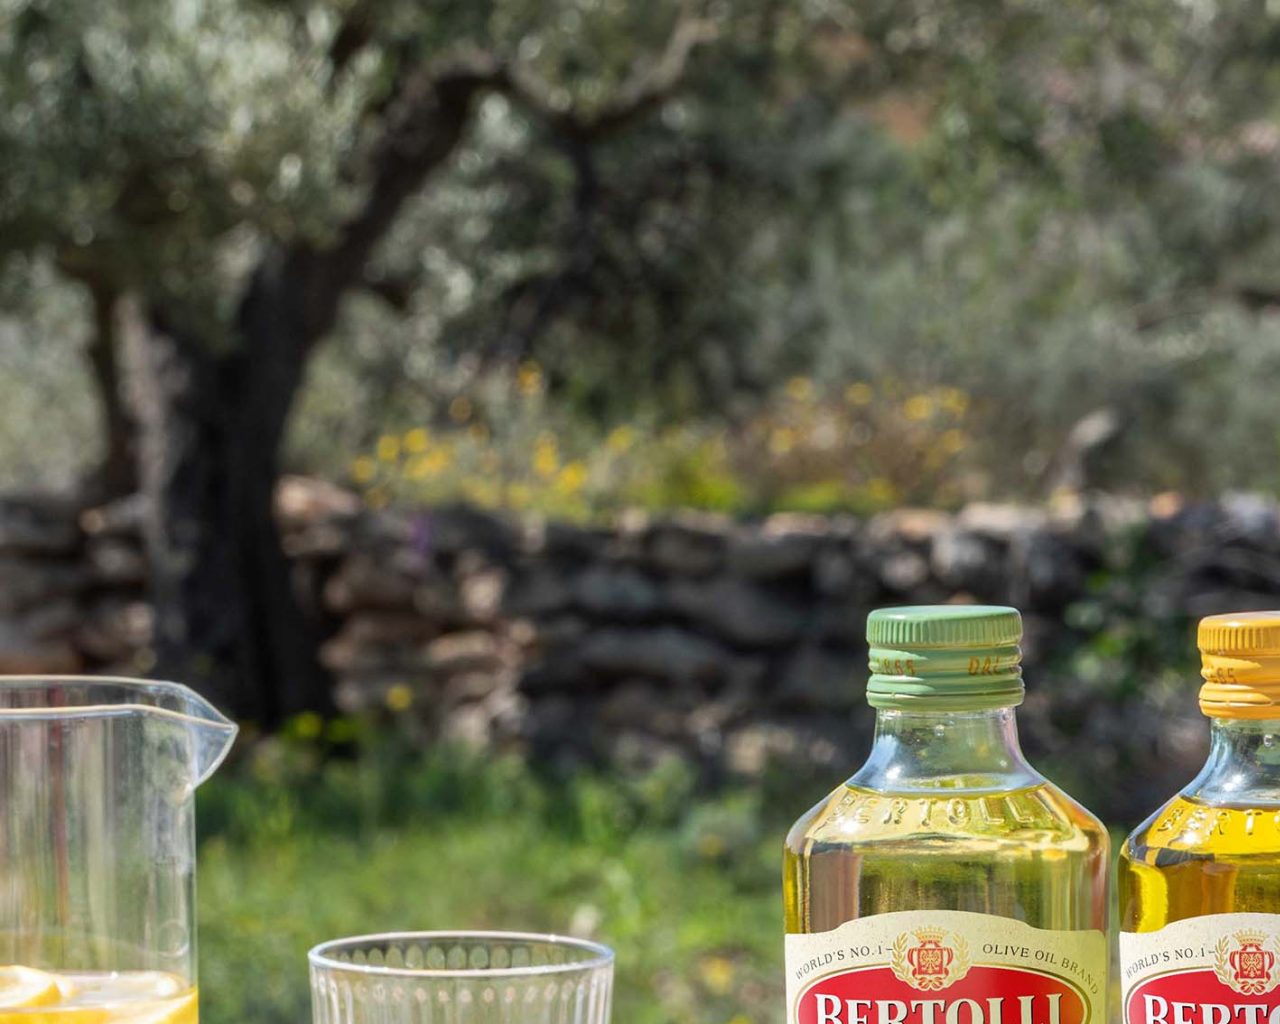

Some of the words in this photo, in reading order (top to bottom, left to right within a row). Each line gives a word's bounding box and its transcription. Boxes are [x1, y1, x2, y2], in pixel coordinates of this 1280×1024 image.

[795, 949, 845, 980] WORLD'S
[982, 943, 1030, 958] OLIVE
[1034, 949, 1058, 964] OIL
[1061, 957, 1099, 995] BRAND
[1125, 951, 1170, 979] WORLD'S
